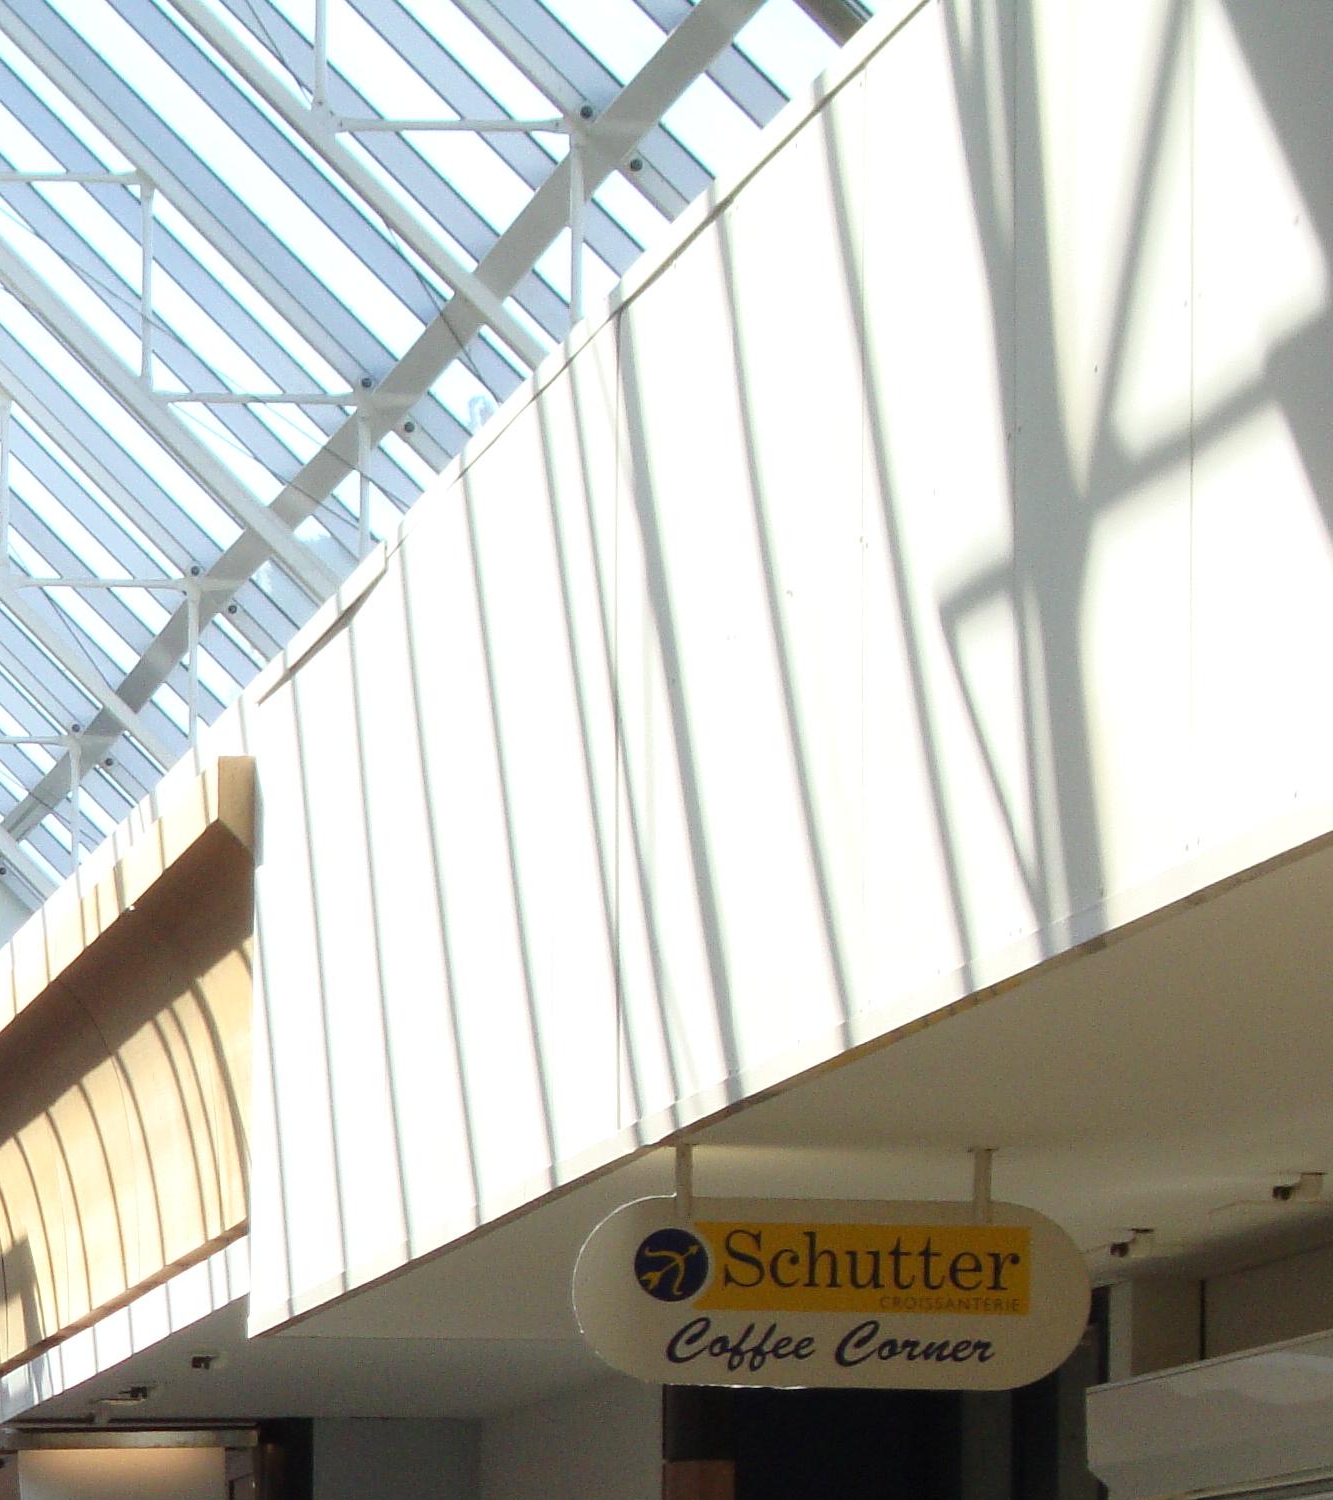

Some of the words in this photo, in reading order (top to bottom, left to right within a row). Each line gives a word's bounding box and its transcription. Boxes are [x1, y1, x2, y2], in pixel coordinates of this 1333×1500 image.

[724, 1230, 1019, 1291] Schutter
[879, 1296, 1020, 1312] CROISSANTERIE
[667, 1317, 815, 1371] Coffee
[835, 1320, 995, 1369] Corner
